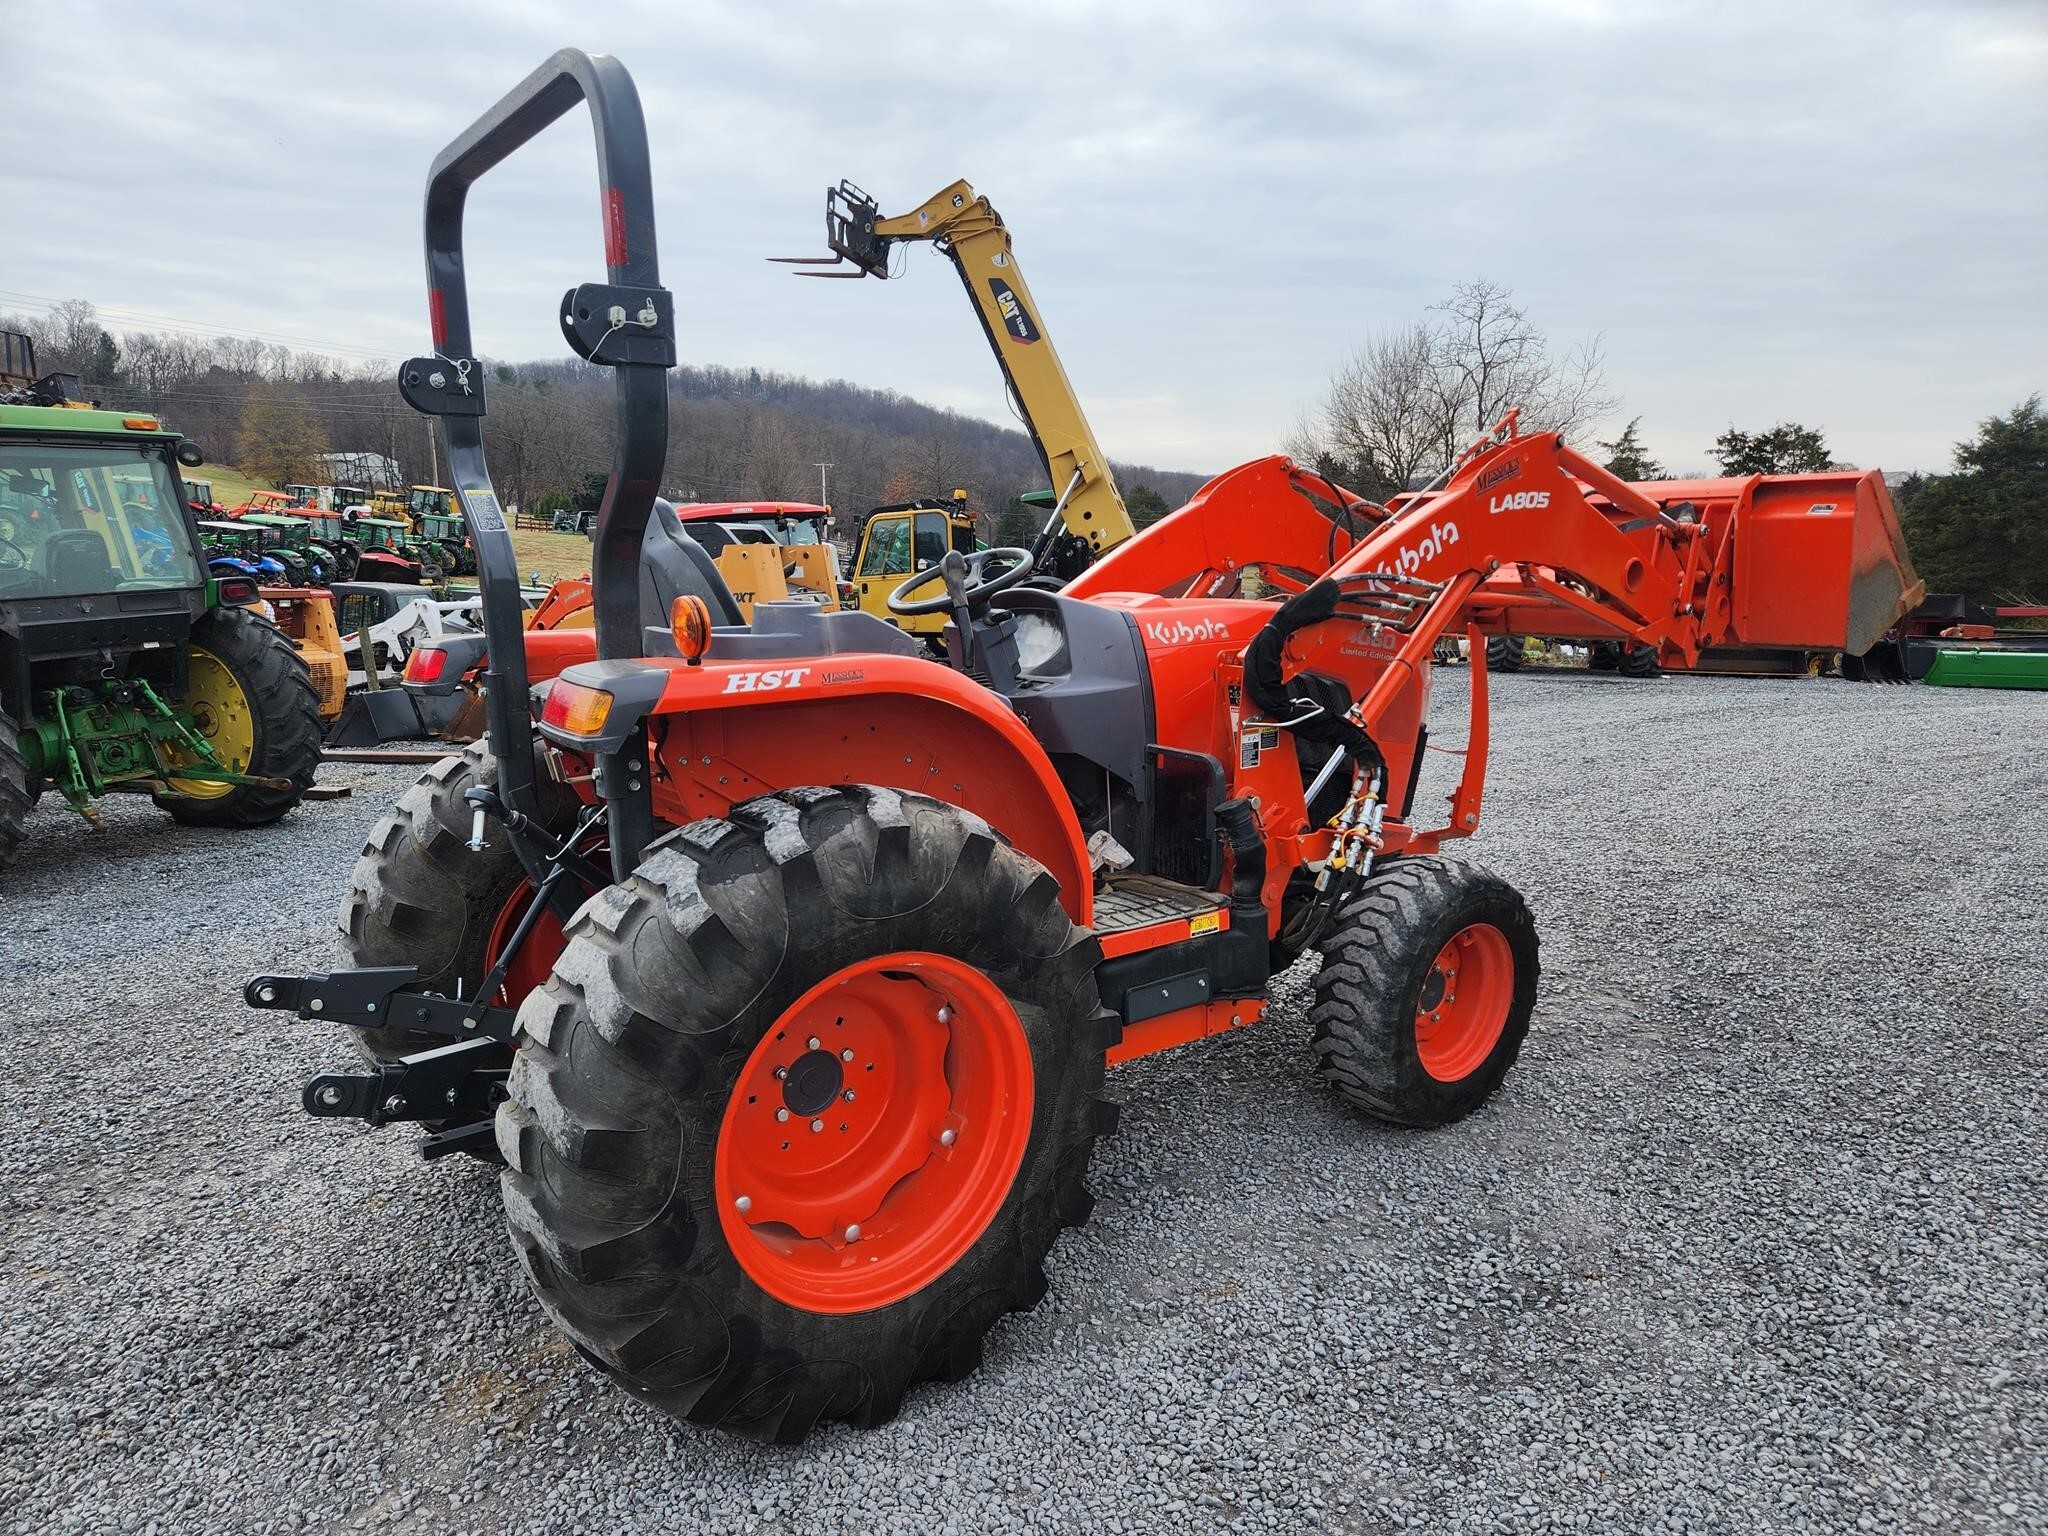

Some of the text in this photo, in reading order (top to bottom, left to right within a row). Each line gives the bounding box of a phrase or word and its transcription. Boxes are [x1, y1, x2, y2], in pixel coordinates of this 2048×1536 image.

[997, 290, 1020, 320] CAT
[1490, 491, 1550, 514] LA805
[1367, 521, 1460, 592] Kubota
[1146, 618, 1230, 644] Kubota
[1340, 647, 1368, 657] Limited
[722, 668, 811, 694] HST
